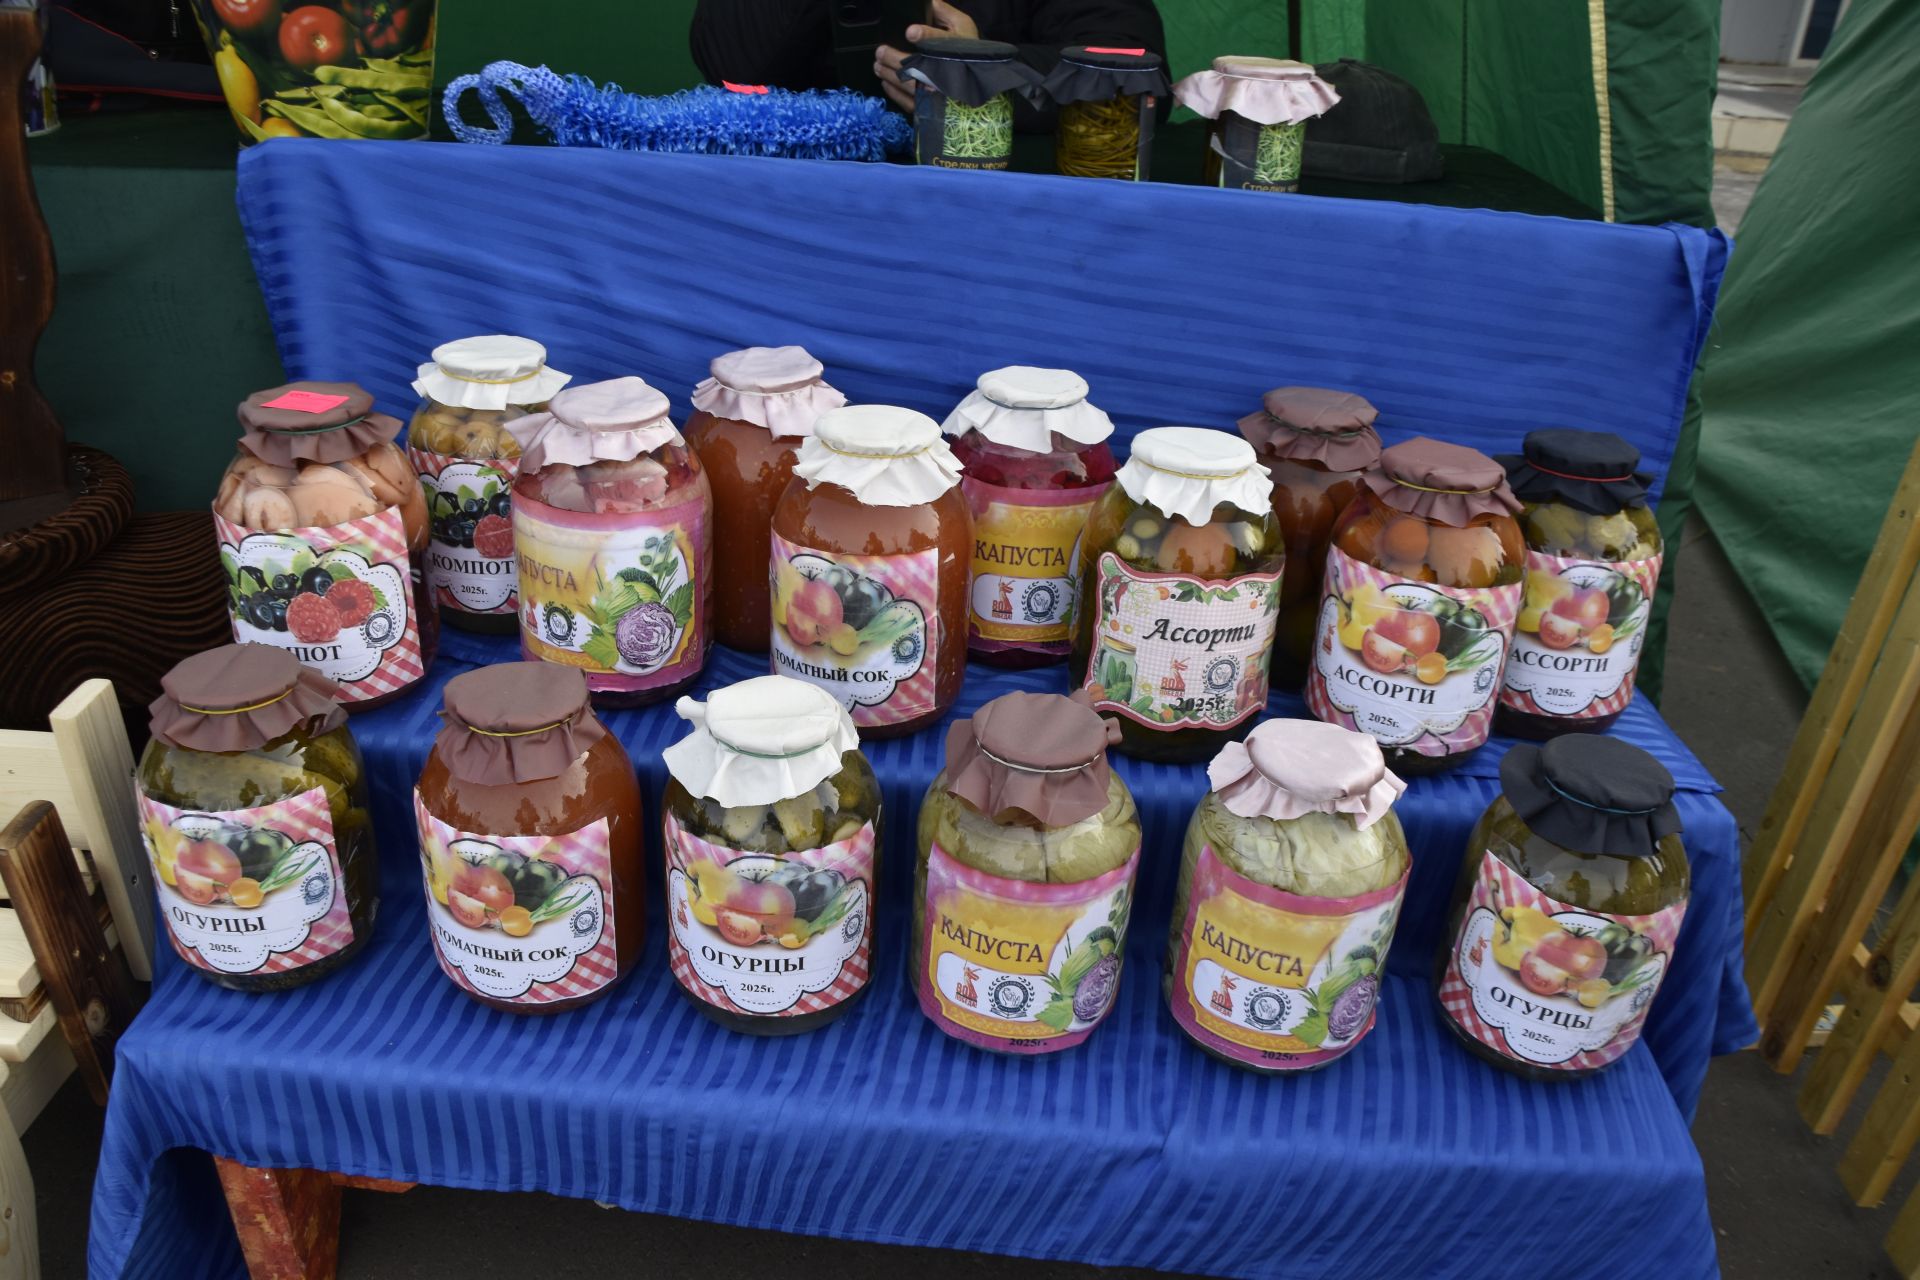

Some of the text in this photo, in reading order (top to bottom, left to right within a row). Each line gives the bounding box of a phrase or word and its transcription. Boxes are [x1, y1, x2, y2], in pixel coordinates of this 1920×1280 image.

[932, 156, 979, 170] Стрелки
[431, 552, 515, 576] КОМПОТ
[975, 539, 1066, 567] КАПУСТА
[517, 552, 578, 592] АПУСТА
[460, 584, 488, 596] 2025г.
[1142, 618, 1256, 652] Ассорти
[286, 644, 343, 663] ПОТ
[774, 648, 889, 683] ТОМАТНЫЙ СОК
[1509, 648, 1609, 673] АССОРТИ
[1333, 664, 1437, 705] АССОРТИ
[1545, 687, 1576, 698] 2025г.
[1368, 712, 1400, 728] 2025г.
[172, 905, 267, 936] ОГУРЦЫ
[208, 942, 242, 953] 2025г.
[436, 923, 568, 962] ТОМАТНЫЙ СОК
[940, 913, 1044, 964] КАПУСТА
[1200, 919, 1304, 977] КАПУСТА
[473, 964, 505, 979] 2025г.
[701, 945, 806, 976] ОГУРЦЫ
[740, 982, 775, 993] 2025г.
[1489, 985, 1594, 1031] ОГУРЦЫ
[1521, 1028, 1556, 1046] 2025г.
[1260, 1049, 1300, 1061] 2025г.
